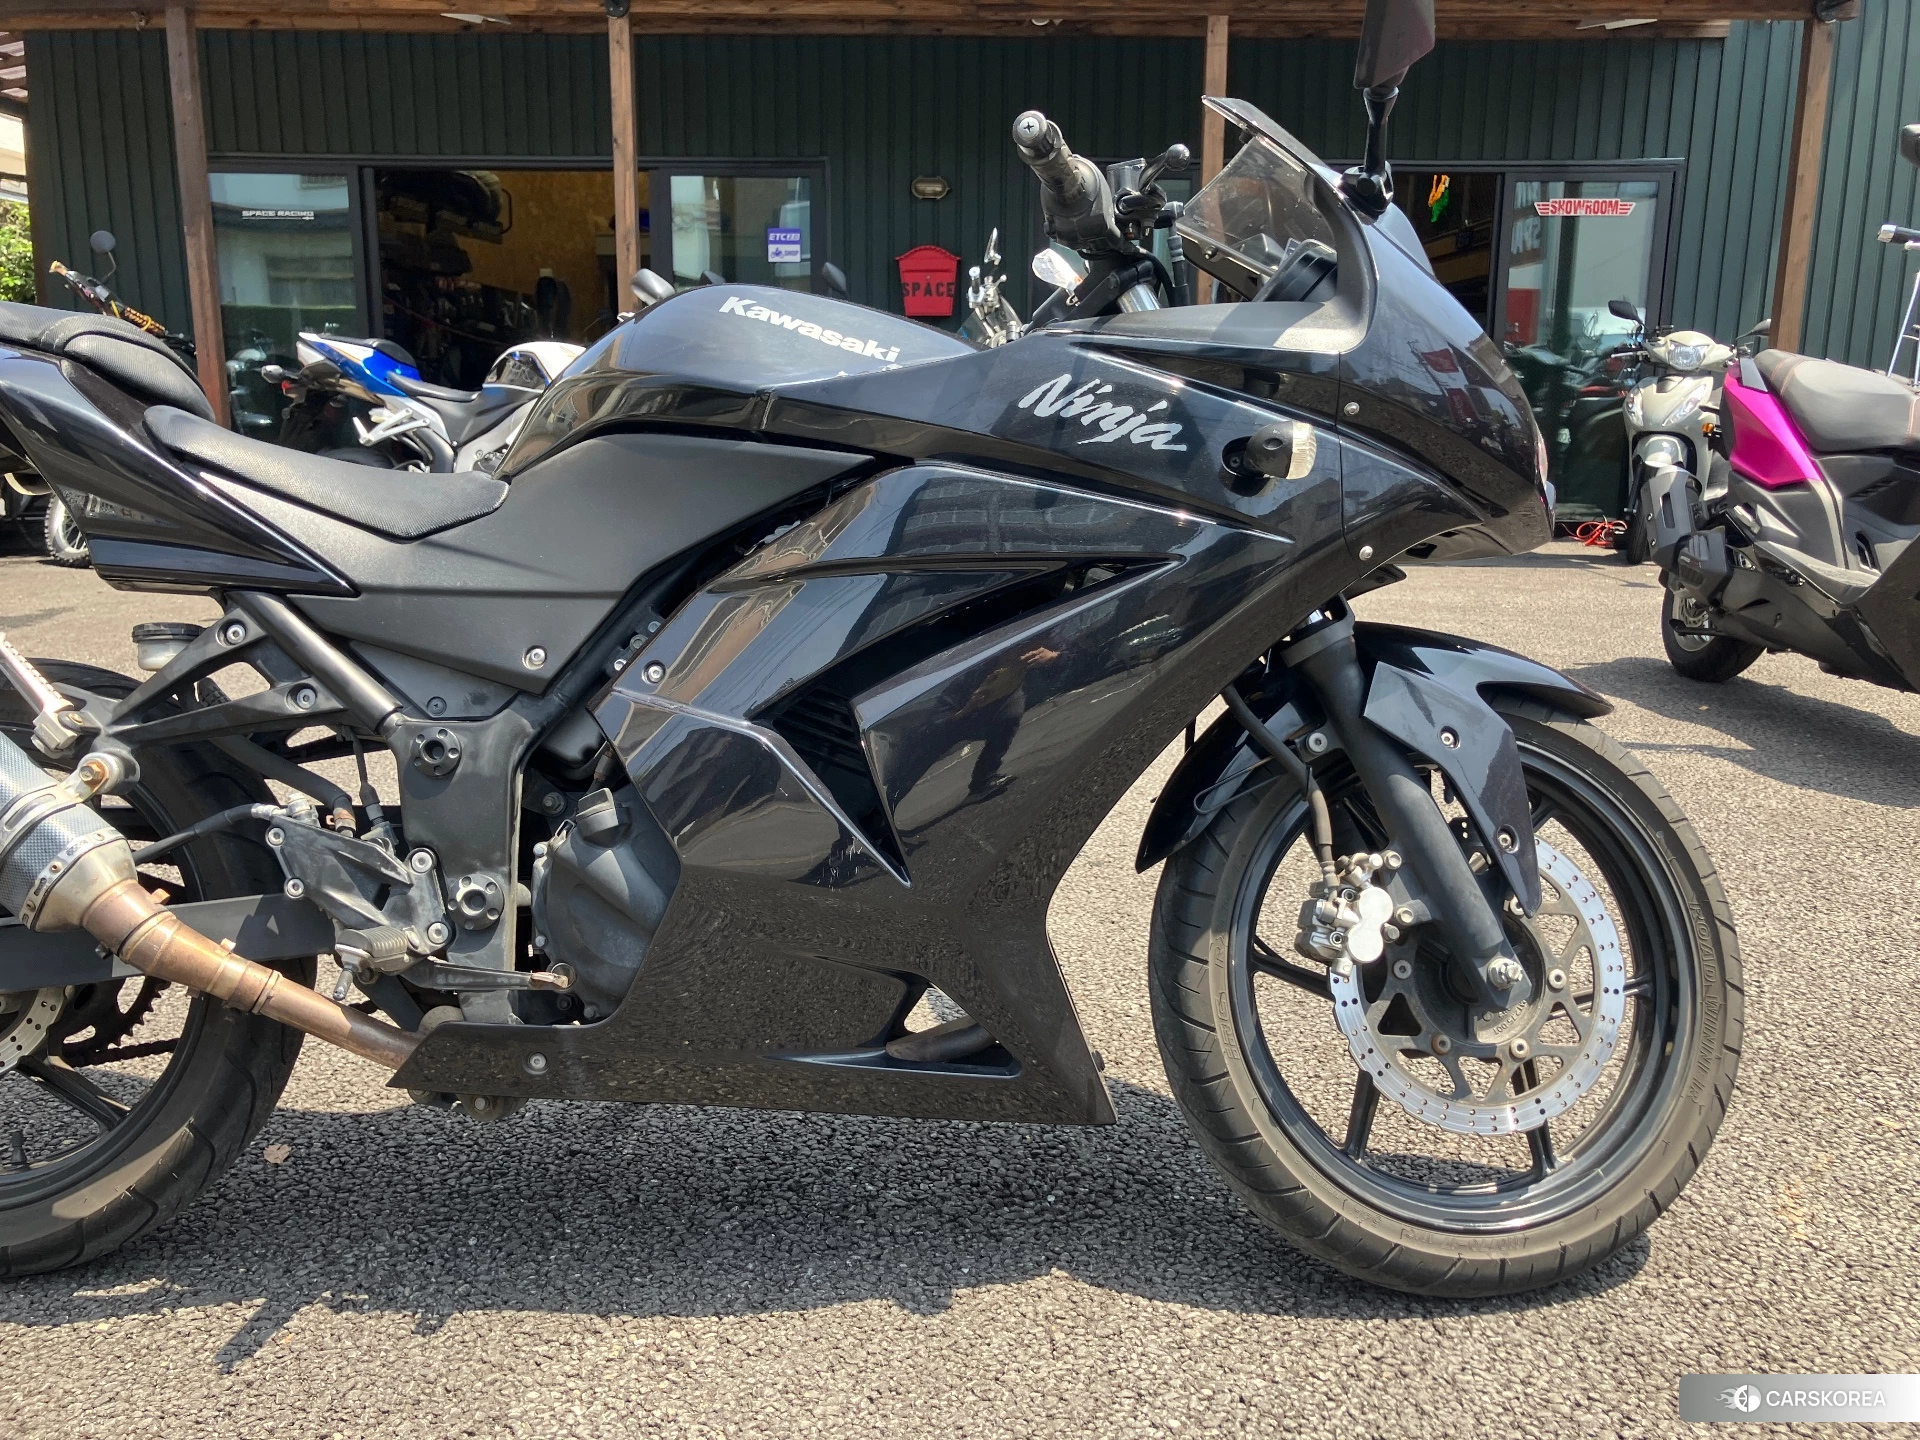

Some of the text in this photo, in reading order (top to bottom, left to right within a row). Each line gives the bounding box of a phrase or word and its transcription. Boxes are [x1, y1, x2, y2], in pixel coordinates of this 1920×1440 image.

[1550, 199, 1619, 215] SHOWROOM
[901, 282, 956, 298] SPACE
[718, 296, 901, 363] Kawasaki
[1018, 373, 1188, 452] Ninja
[1688, 901, 1717, 983] ROAD
